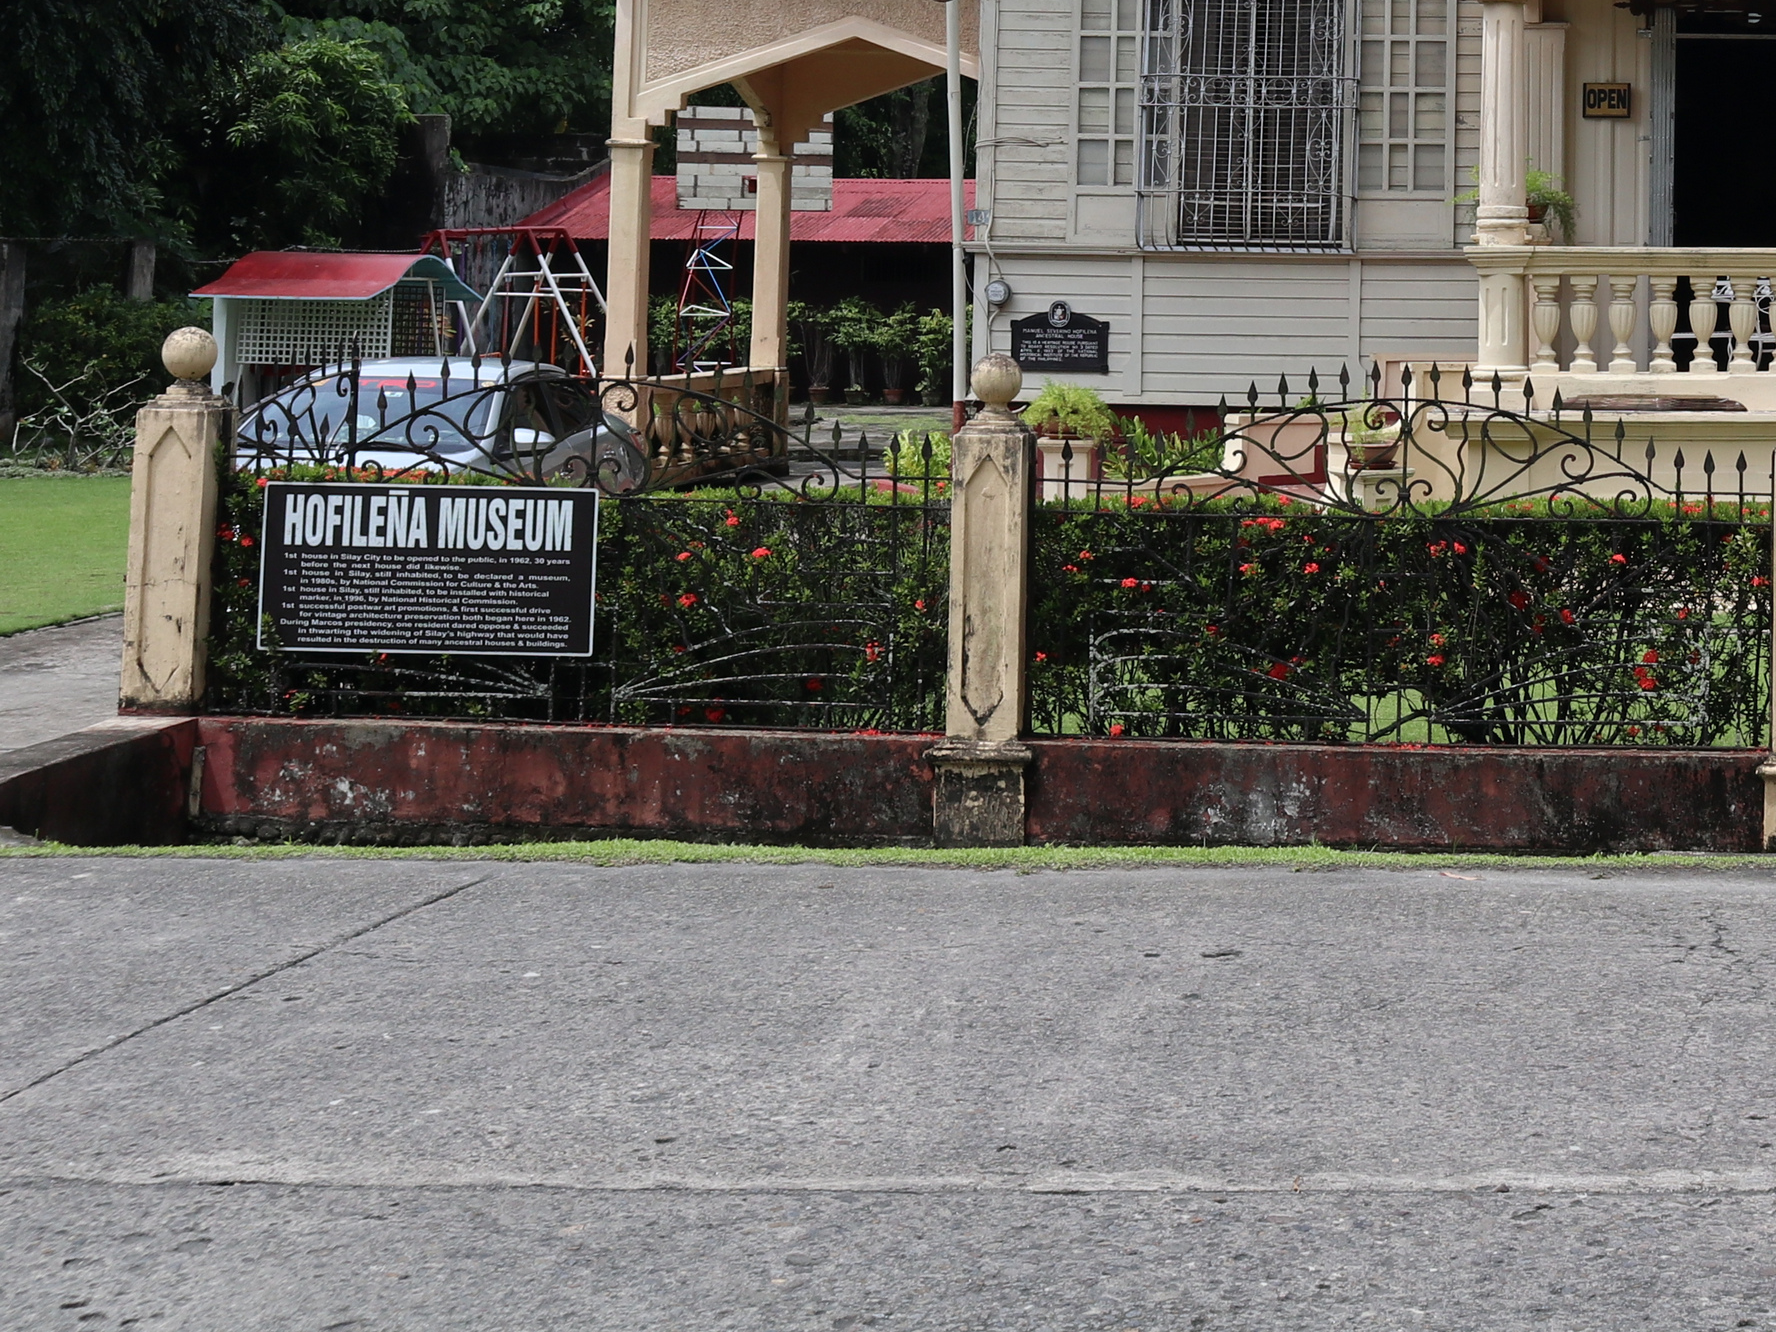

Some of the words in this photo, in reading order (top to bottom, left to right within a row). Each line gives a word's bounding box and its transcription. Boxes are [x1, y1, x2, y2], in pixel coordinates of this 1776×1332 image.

[1587, 89, 1627, 109] OPEN
[283, 488, 430, 548] HOFILEÑA
[437, 497, 573, 552] MUSEUM
[340, 553, 361, 561] Silay
[347, 603, 381, 611] postwar
[314, 611, 346, 619] vintage
[349, 611, 402, 619] architecture
[404, 612, 460, 621] preservation
[485, 614, 512, 622] began
[280, 618, 309, 626] During
[308, 627, 351, 635] thwarting
[370, 629, 411, 637] widening
[457, 630, 495, 638] highway
[526, 640, 567, 648] buildings.
